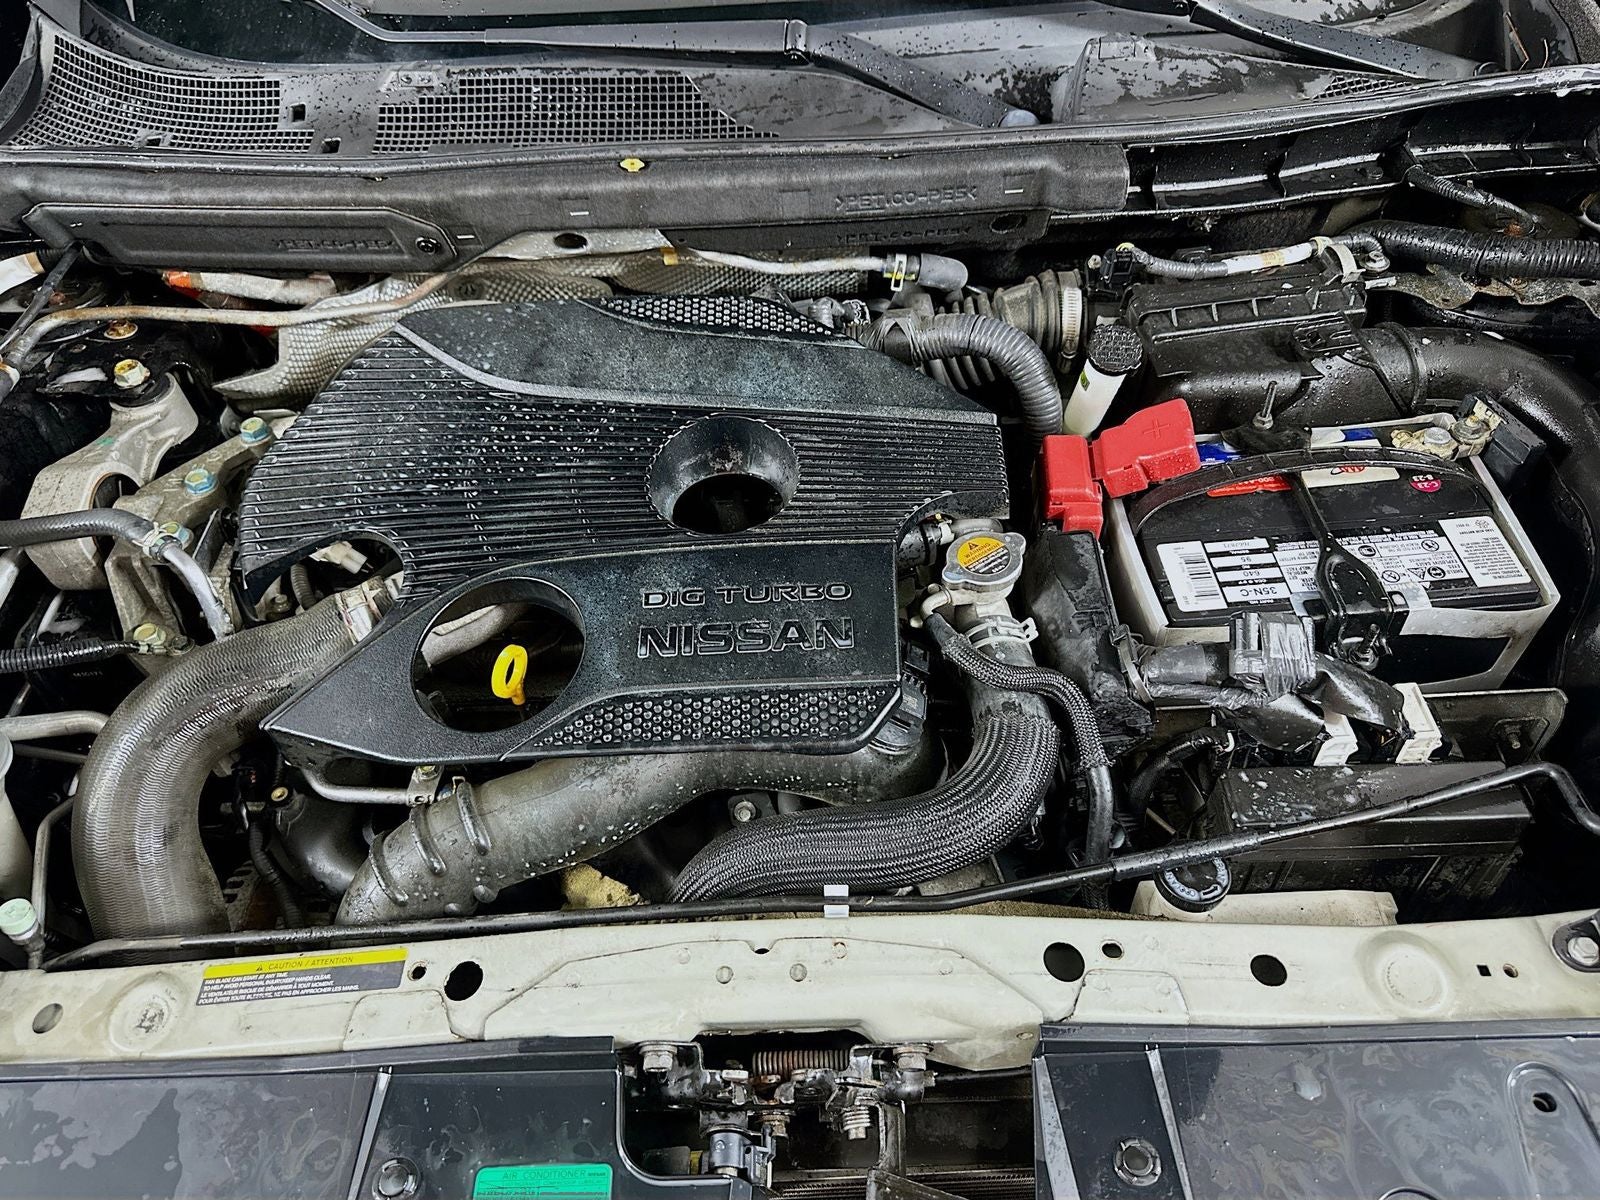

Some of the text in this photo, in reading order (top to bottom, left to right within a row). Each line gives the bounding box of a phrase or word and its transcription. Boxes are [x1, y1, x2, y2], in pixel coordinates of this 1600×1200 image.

[1412, 474, 1434, 482] B-23
[1417, 481, 1439, 489] C-23
[642, 582, 853, 609] DIG TURBO
[1240, 586, 1277, 597] 35N-C
[637, 617, 855, 658] NISSAN
[268, 960, 303, 970] CAUTION
[311, 956, 354, 966] ATTENTION
[502, 1172, 517, 1181] AIR
[523, 1169, 586, 1180] CONDITIONER
